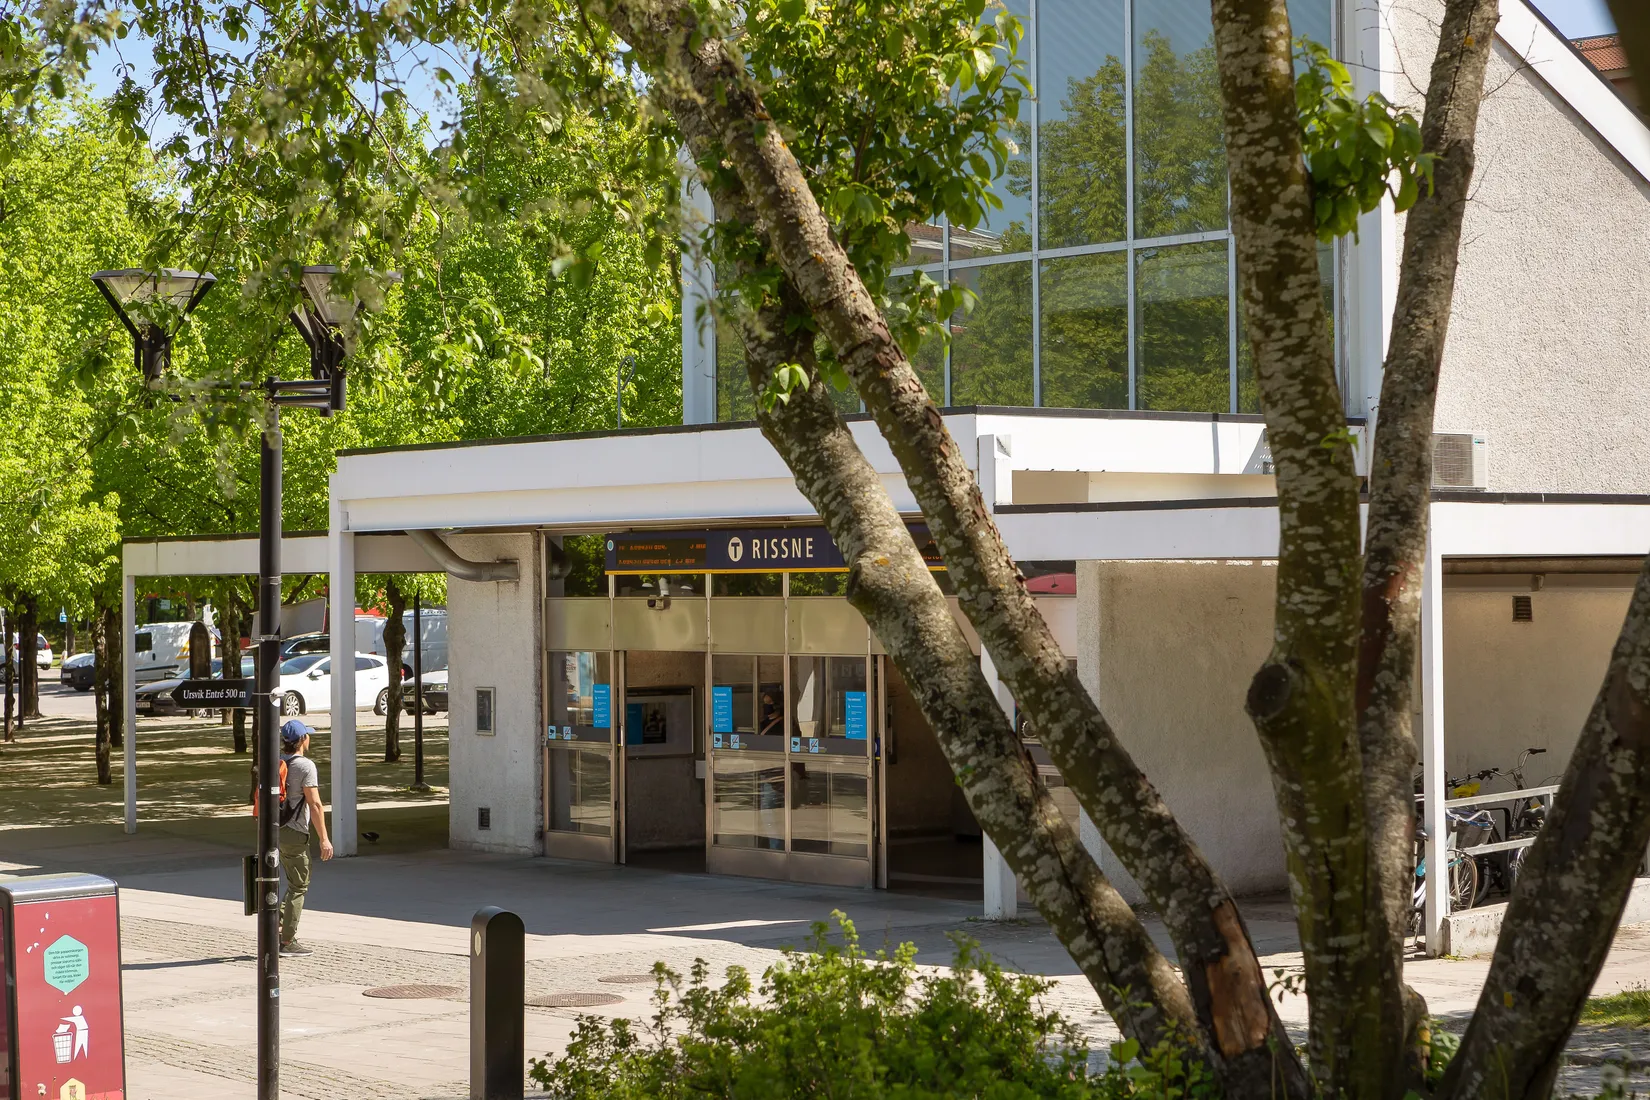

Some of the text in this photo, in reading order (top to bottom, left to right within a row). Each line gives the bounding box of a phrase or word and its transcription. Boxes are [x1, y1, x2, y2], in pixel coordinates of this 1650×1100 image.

[730, 537, 814, 560] T RISSNE
[183, 689, 204, 699] Ursvik
[205, 688, 224, 699] Entré
[225, 688, 238, 699] 500
